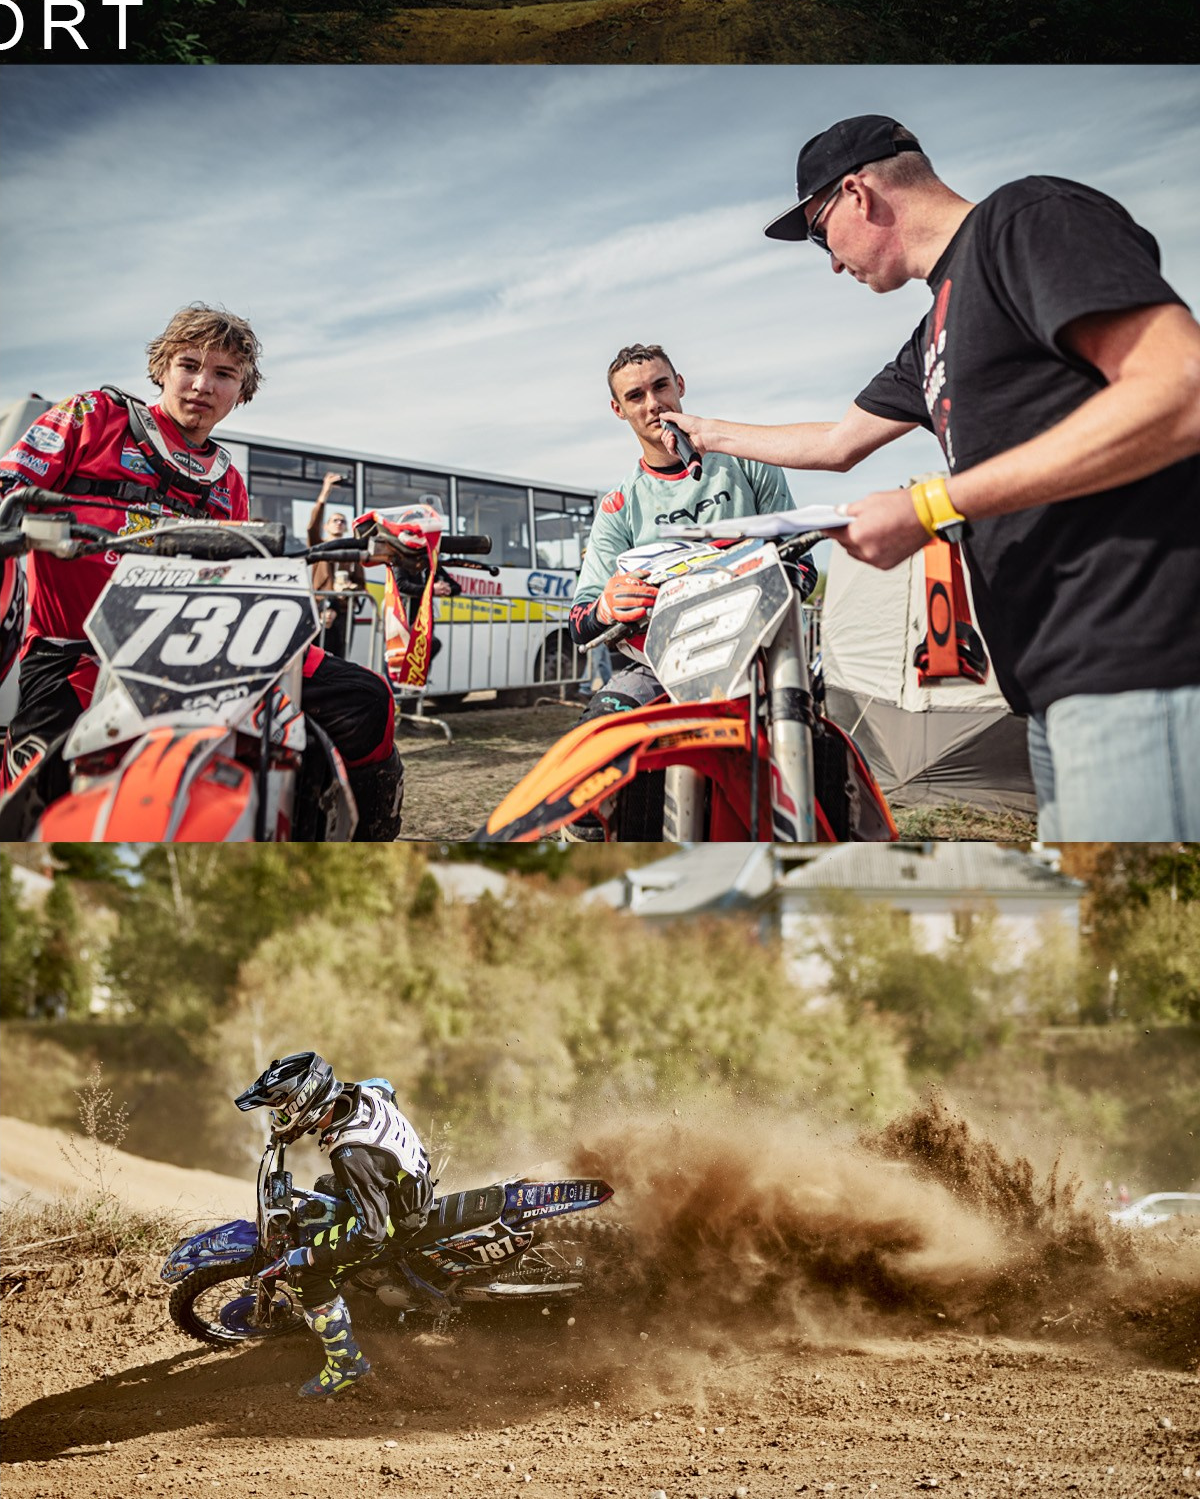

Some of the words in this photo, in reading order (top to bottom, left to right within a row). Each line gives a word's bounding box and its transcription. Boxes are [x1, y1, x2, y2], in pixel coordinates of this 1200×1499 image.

[121, 567, 196, 587] Savva
[110, 594, 303, 667] 730
[656, 585, 763, 689] 2
[523, 1202, 574, 1218] DUNLOP
[473, 1235, 515, 1263] 787
